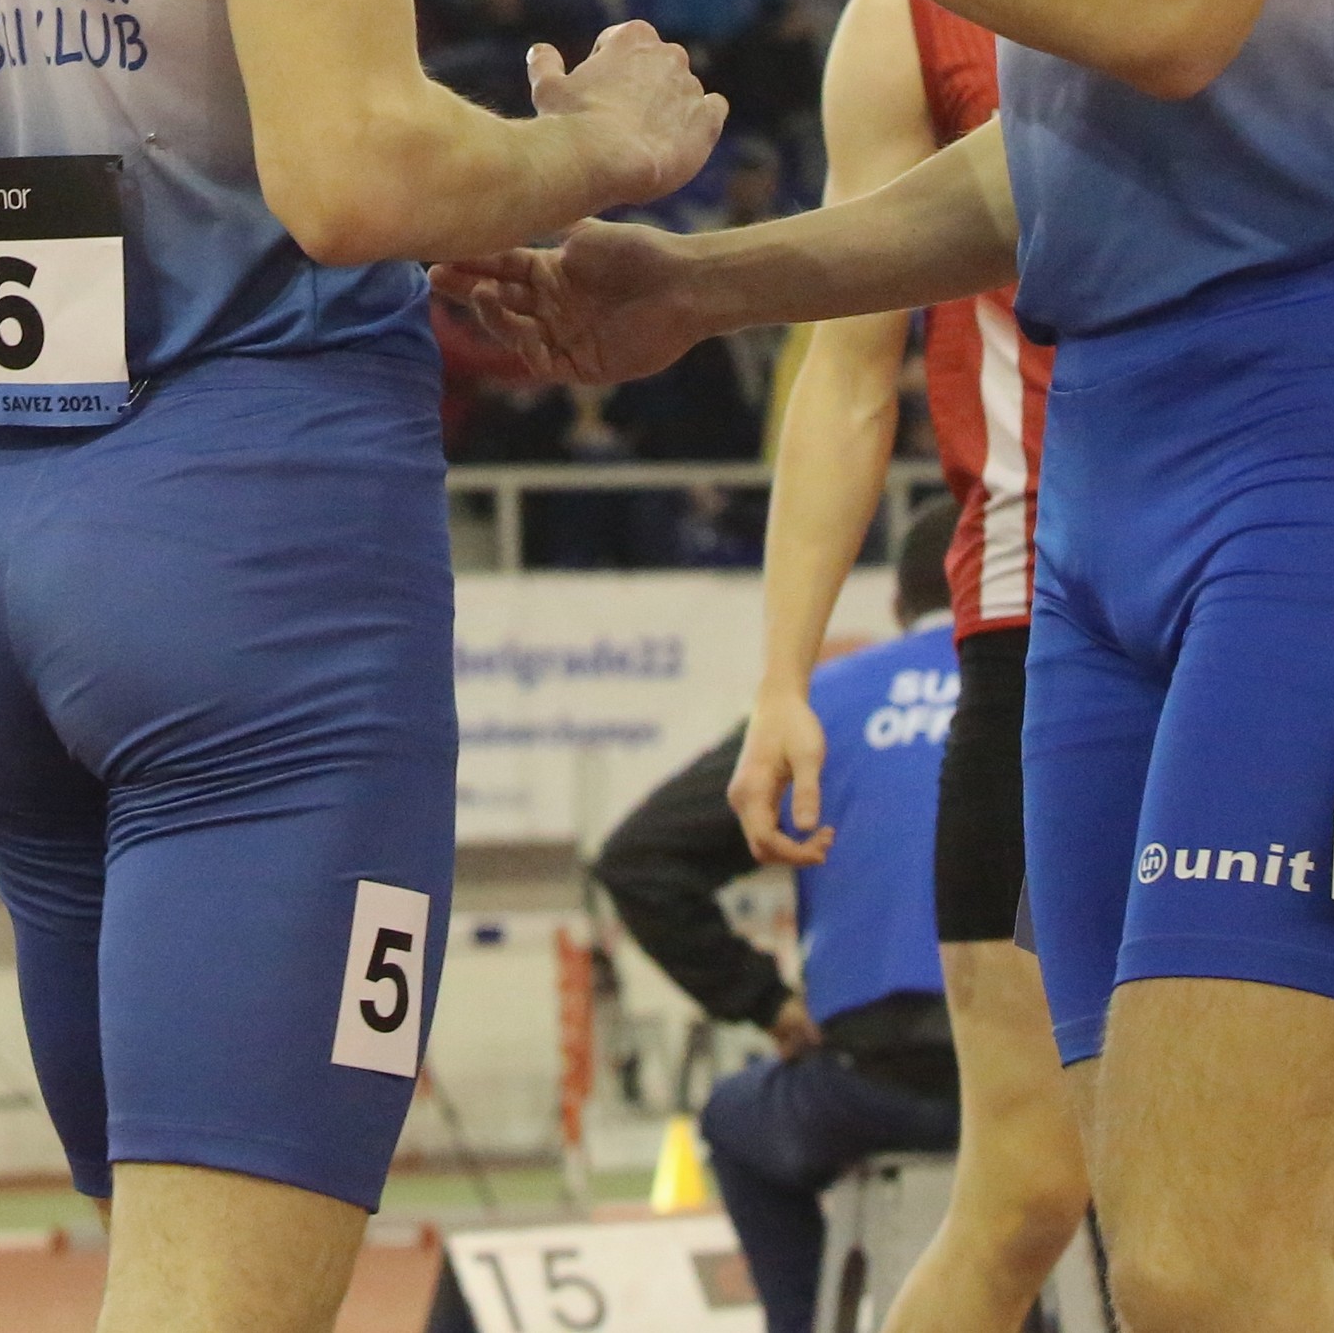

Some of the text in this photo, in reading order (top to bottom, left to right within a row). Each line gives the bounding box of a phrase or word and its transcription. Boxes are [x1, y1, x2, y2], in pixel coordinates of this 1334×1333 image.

[35, 7, 147, 71] LUB
[2, 395, 53, 413] SAVEZ
[57, 395, 110, 413] 2021.
[1174, 843, 1315, 892] unit
[359, 927, 413, 1034] 5
[474, 1245, 605, 1333] 15
